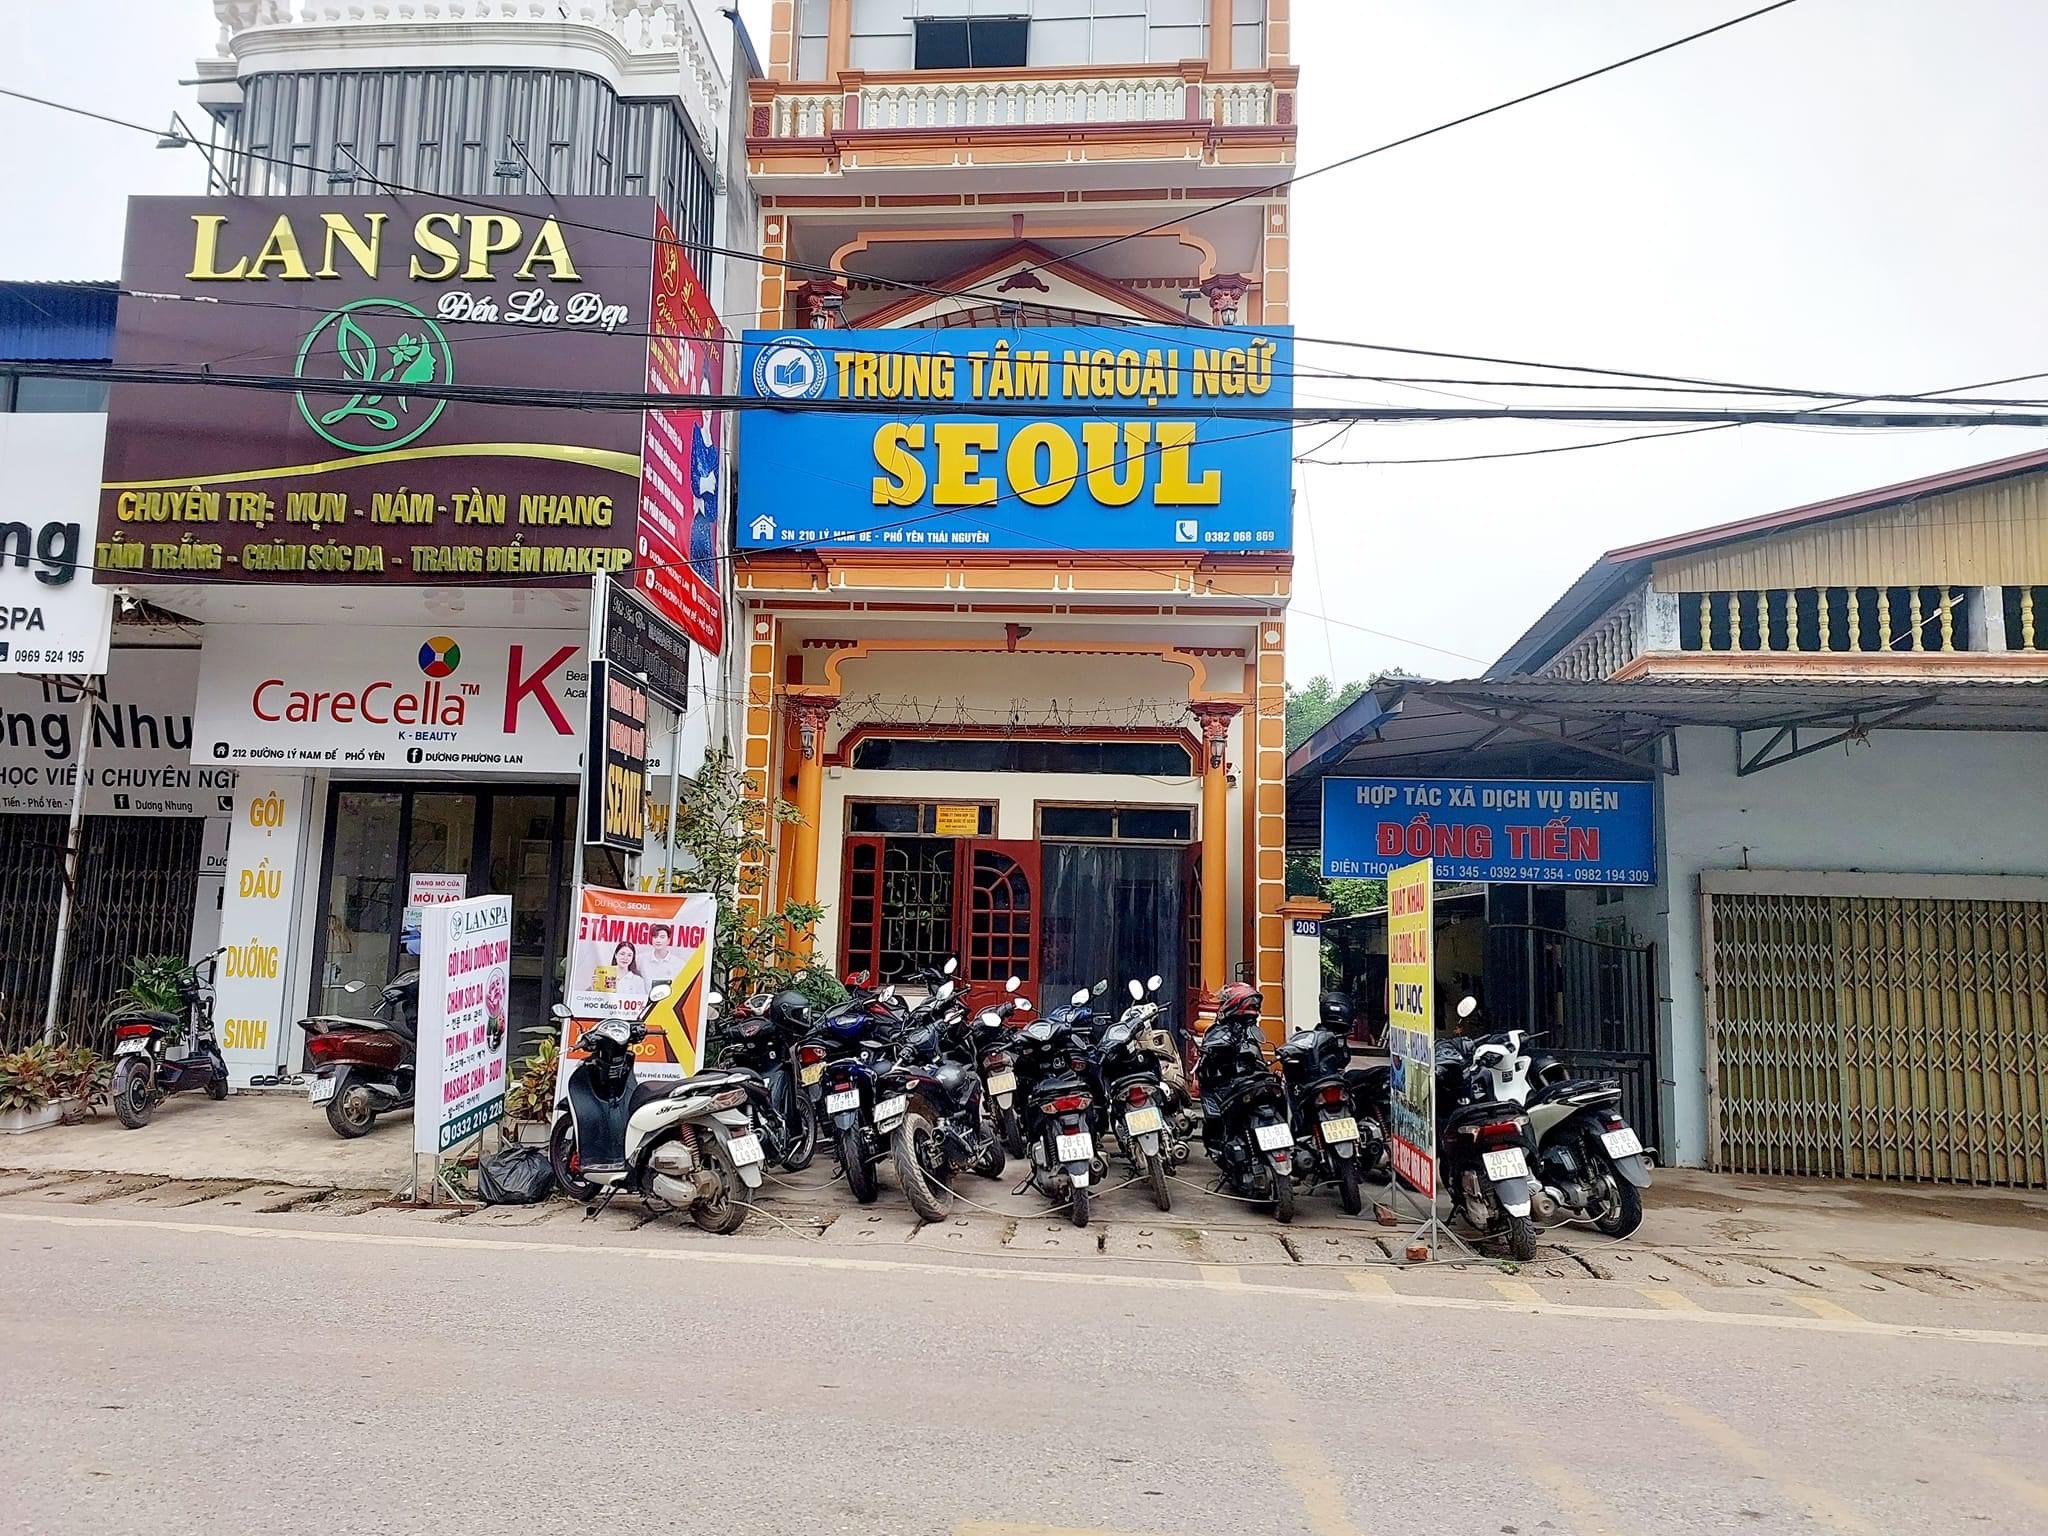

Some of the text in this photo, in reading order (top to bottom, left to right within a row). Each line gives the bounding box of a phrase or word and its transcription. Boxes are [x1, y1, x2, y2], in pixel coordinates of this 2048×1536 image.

[185, 212, 583, 281] LAN SPA
[437, 287, 630, 332] Đến Là Đẹp
[834, 337, 1277, 407] TRUNG TÂM NGOẠI NGỮ
[872, 421, 1221, 507] SEOUL
[117, 486, 220, 522] CHUYÊN
[286, 492, 347, 531] MỤN
[370, 486, 434, 525] NÁM
[452, 487, 506, 525] TÀN
[518, 495, 613, 526] NHANG
[799, 529, 815, 541] 210
[905, 529, 923, 543] YÊN
[951, 530, 989, 543] NGUYÊN
[1204, 531, 1230, 542] 0382
[307, 538, 352, 571] SÓC
[353, 546, 384, 572] DA
[411, 546, 483, 572] TRANG
[486, 532, 541, 573] ĐIỂM
[542, 547, 633, 573] MAKEUP
[14, 650, 85, 663] 0969 524 195
[503, 645, 581, 735] K
[566, 670, 588, 682] Bea
[252, 679, 466, 726] CareCella
[398, 731, 457, 741] K BEAUTY
[232, 749, 247, 758] 212
[250, 746, 285, 759] ĐƯỜNG
[287, 748, 298, 759] LÝ
[300, 750, 321, 760] NAM
[368, 750, 385, 761] YÊN
[425, 751, 523, 764] DƯƠNG PHƯƠNG LAN
[101, 764, 191, 788] CHUYÊN
[198, 771, 236, 788] NG
[135, 800, 193, 813] Dương Nhung
[250, 790, 285, 837] GỘI
[607, 763, 642, 839] SEOUL
[1357, 783, 1618, 813] HỢP TÁC XÃ DỊCH VỤ ĐIỆN
[1376, 811, 1600, 861] ĐỒNG TIẾN
[239, 857, 282, 899] ĐẦU
[1331, 858, 1649, 882] ĐIỆN 651 345 0392 947 354 0982 194 309
[466, 906, 508, 931] LAN SPA
[592, 915, 624, 943] TÂM
[1296, 921, 1316, 934] 208
[1394, 984, 1423, 1021] DU HỌC
[223, 1018, 267, 1050] SINH
[443, 1073, 470, 1104] MASSAGE
[451, 1100, 503, 1140] 0332 216 228
